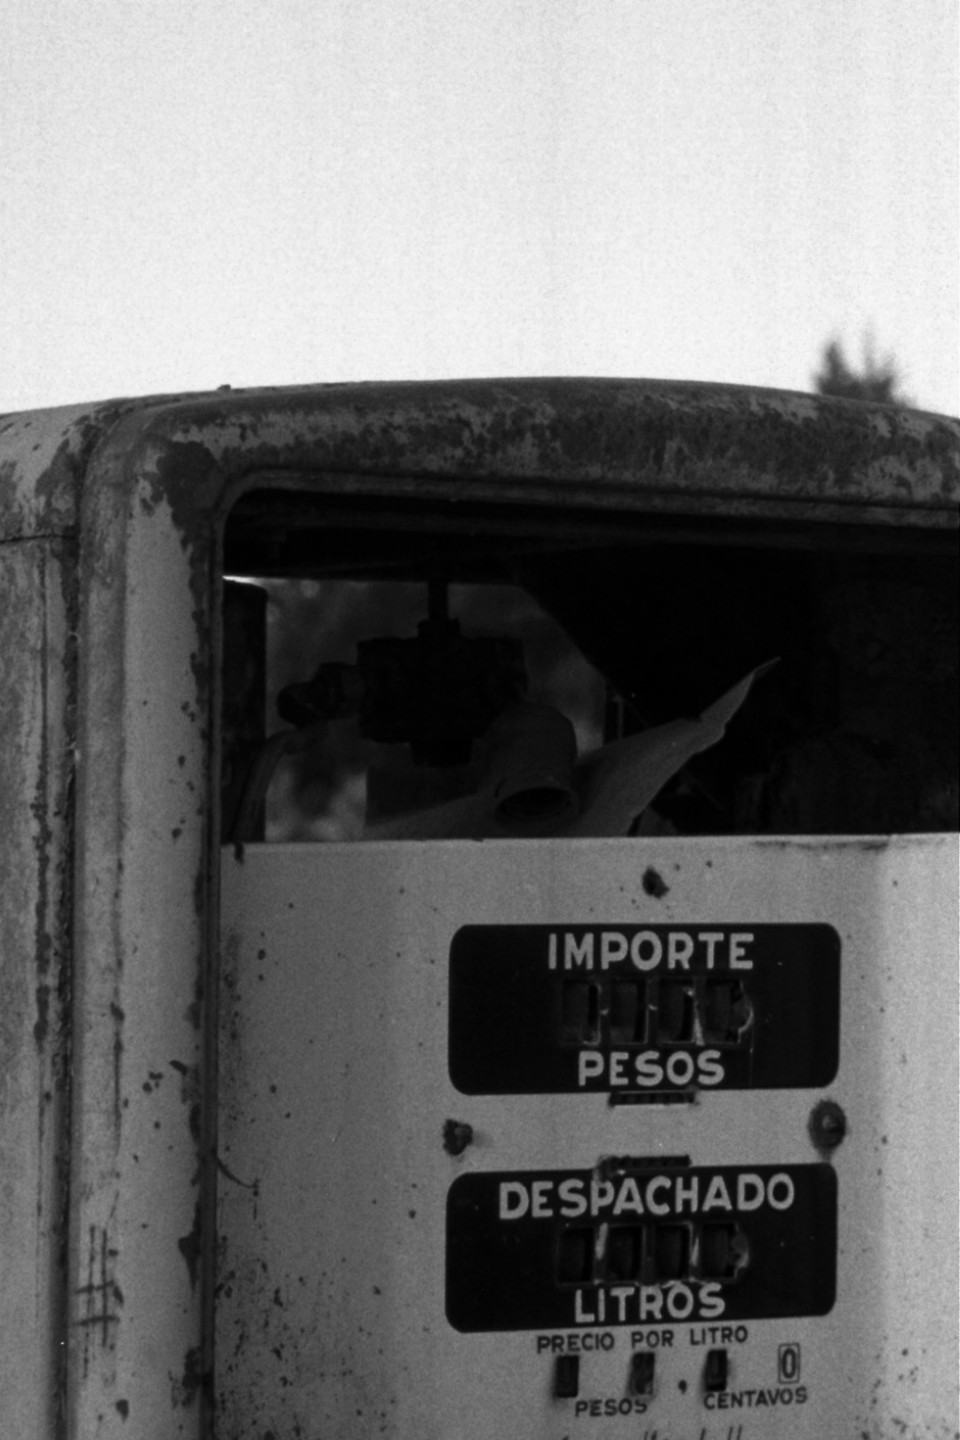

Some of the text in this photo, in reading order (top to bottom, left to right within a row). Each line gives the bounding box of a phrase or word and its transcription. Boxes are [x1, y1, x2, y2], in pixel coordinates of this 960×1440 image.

[548, 930, 755, 971] IMPORTE
[578, 1050, 725, 1086] PESOS
[499, 1173, 795, 1220] DESPACHADO
[574, 1282, 726, 1323] LITROS
[537, 1325, 749, 1353] PRECIO POR LITRO
[575, 1385, 808, 1418] PESOS CENTAVOS
